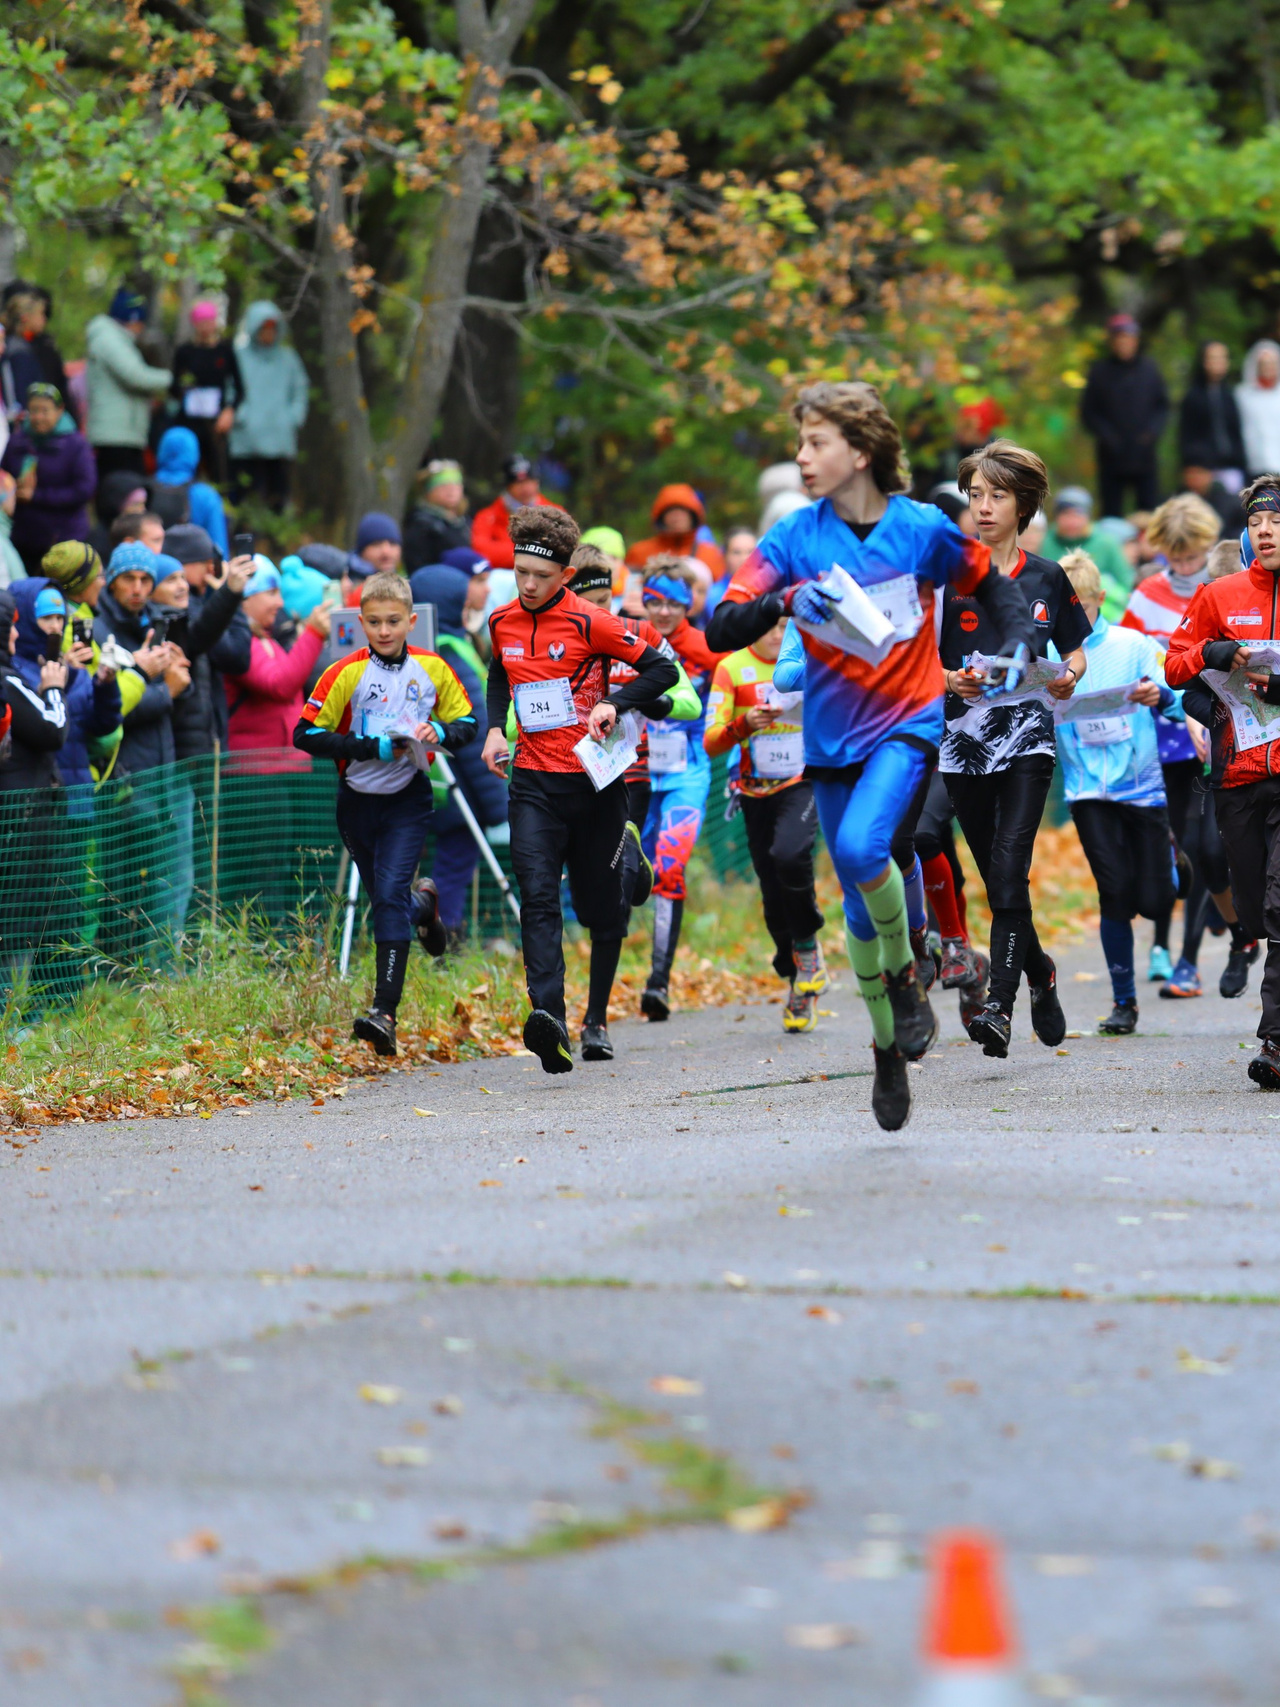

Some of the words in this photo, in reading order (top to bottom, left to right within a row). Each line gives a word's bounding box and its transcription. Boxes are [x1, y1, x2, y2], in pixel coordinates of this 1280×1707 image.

[530, 701, 551, 714] 284
[1087, 721, 1107, 733] 281
[769, 751, 790, 762] 294
[610, 829, 627, 869] nonam
